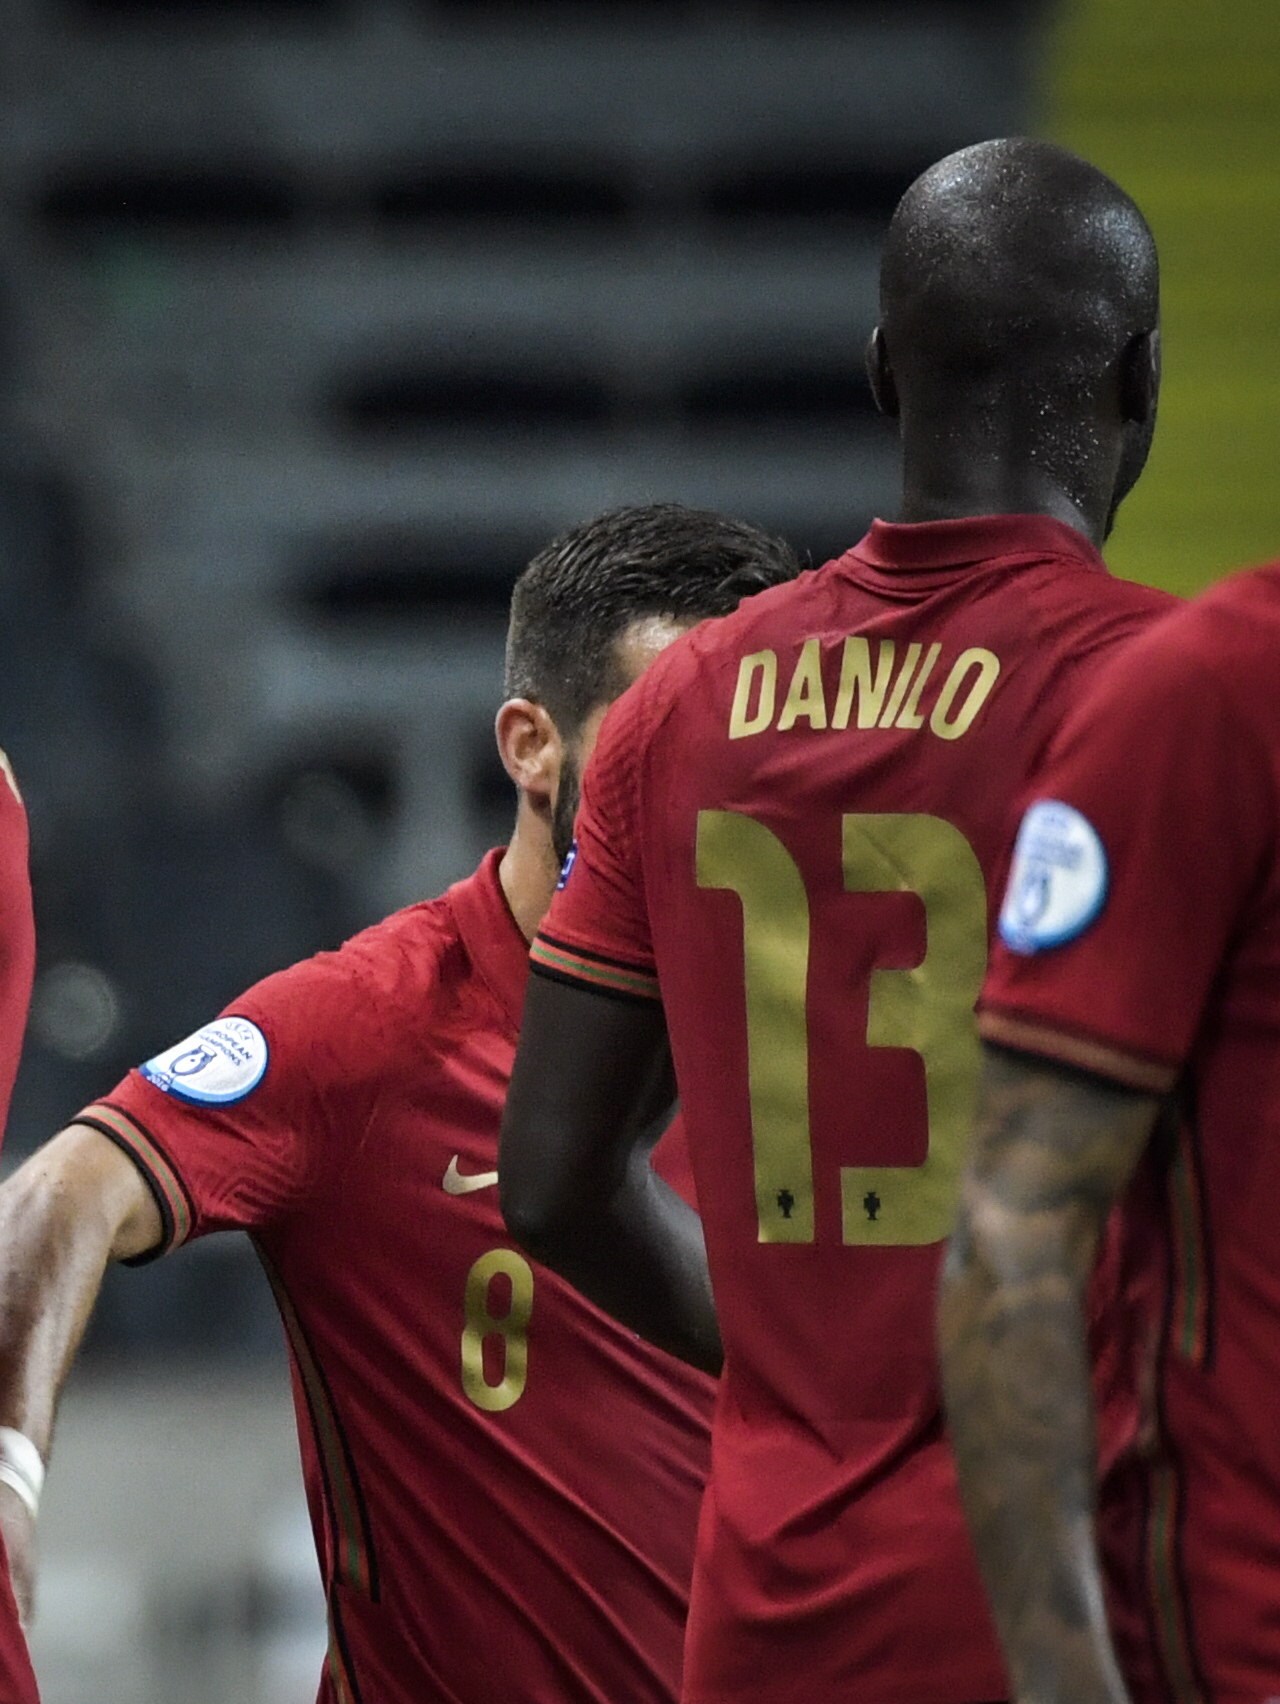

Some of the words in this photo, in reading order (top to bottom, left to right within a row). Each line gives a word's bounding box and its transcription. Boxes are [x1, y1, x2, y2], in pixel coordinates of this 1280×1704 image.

[729, 636, 1000, 740] DANILO
[695, 809, 987, 1246] 13
[461, 1248, 534, 1412] 8
